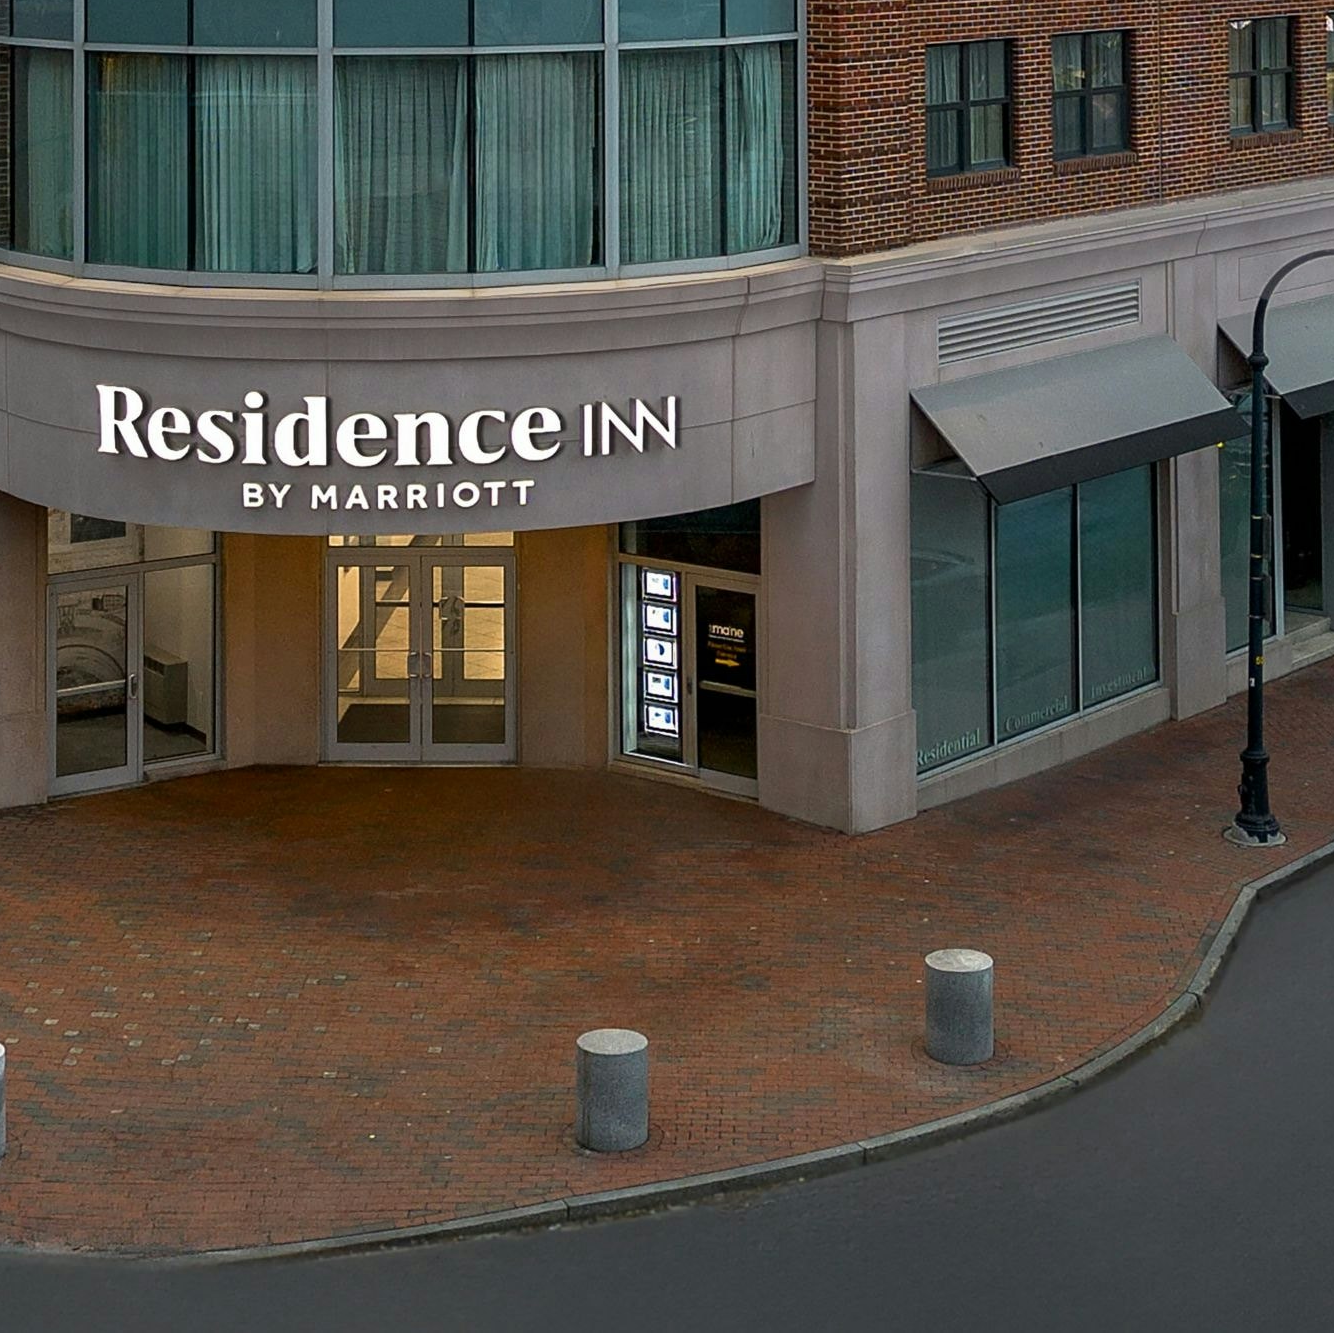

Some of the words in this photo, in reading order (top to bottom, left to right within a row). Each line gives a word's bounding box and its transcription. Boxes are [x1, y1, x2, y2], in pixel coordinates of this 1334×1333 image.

[96, 384, 563, 467] Residence
[581, 395, 681, 457] INN
[243, 481, 291, 508] BY
[310, 479, 536, 510] MARRIOTT
[1006, 696, 1068, 732] Commercial
[917, 728, 981, 767] Residential
